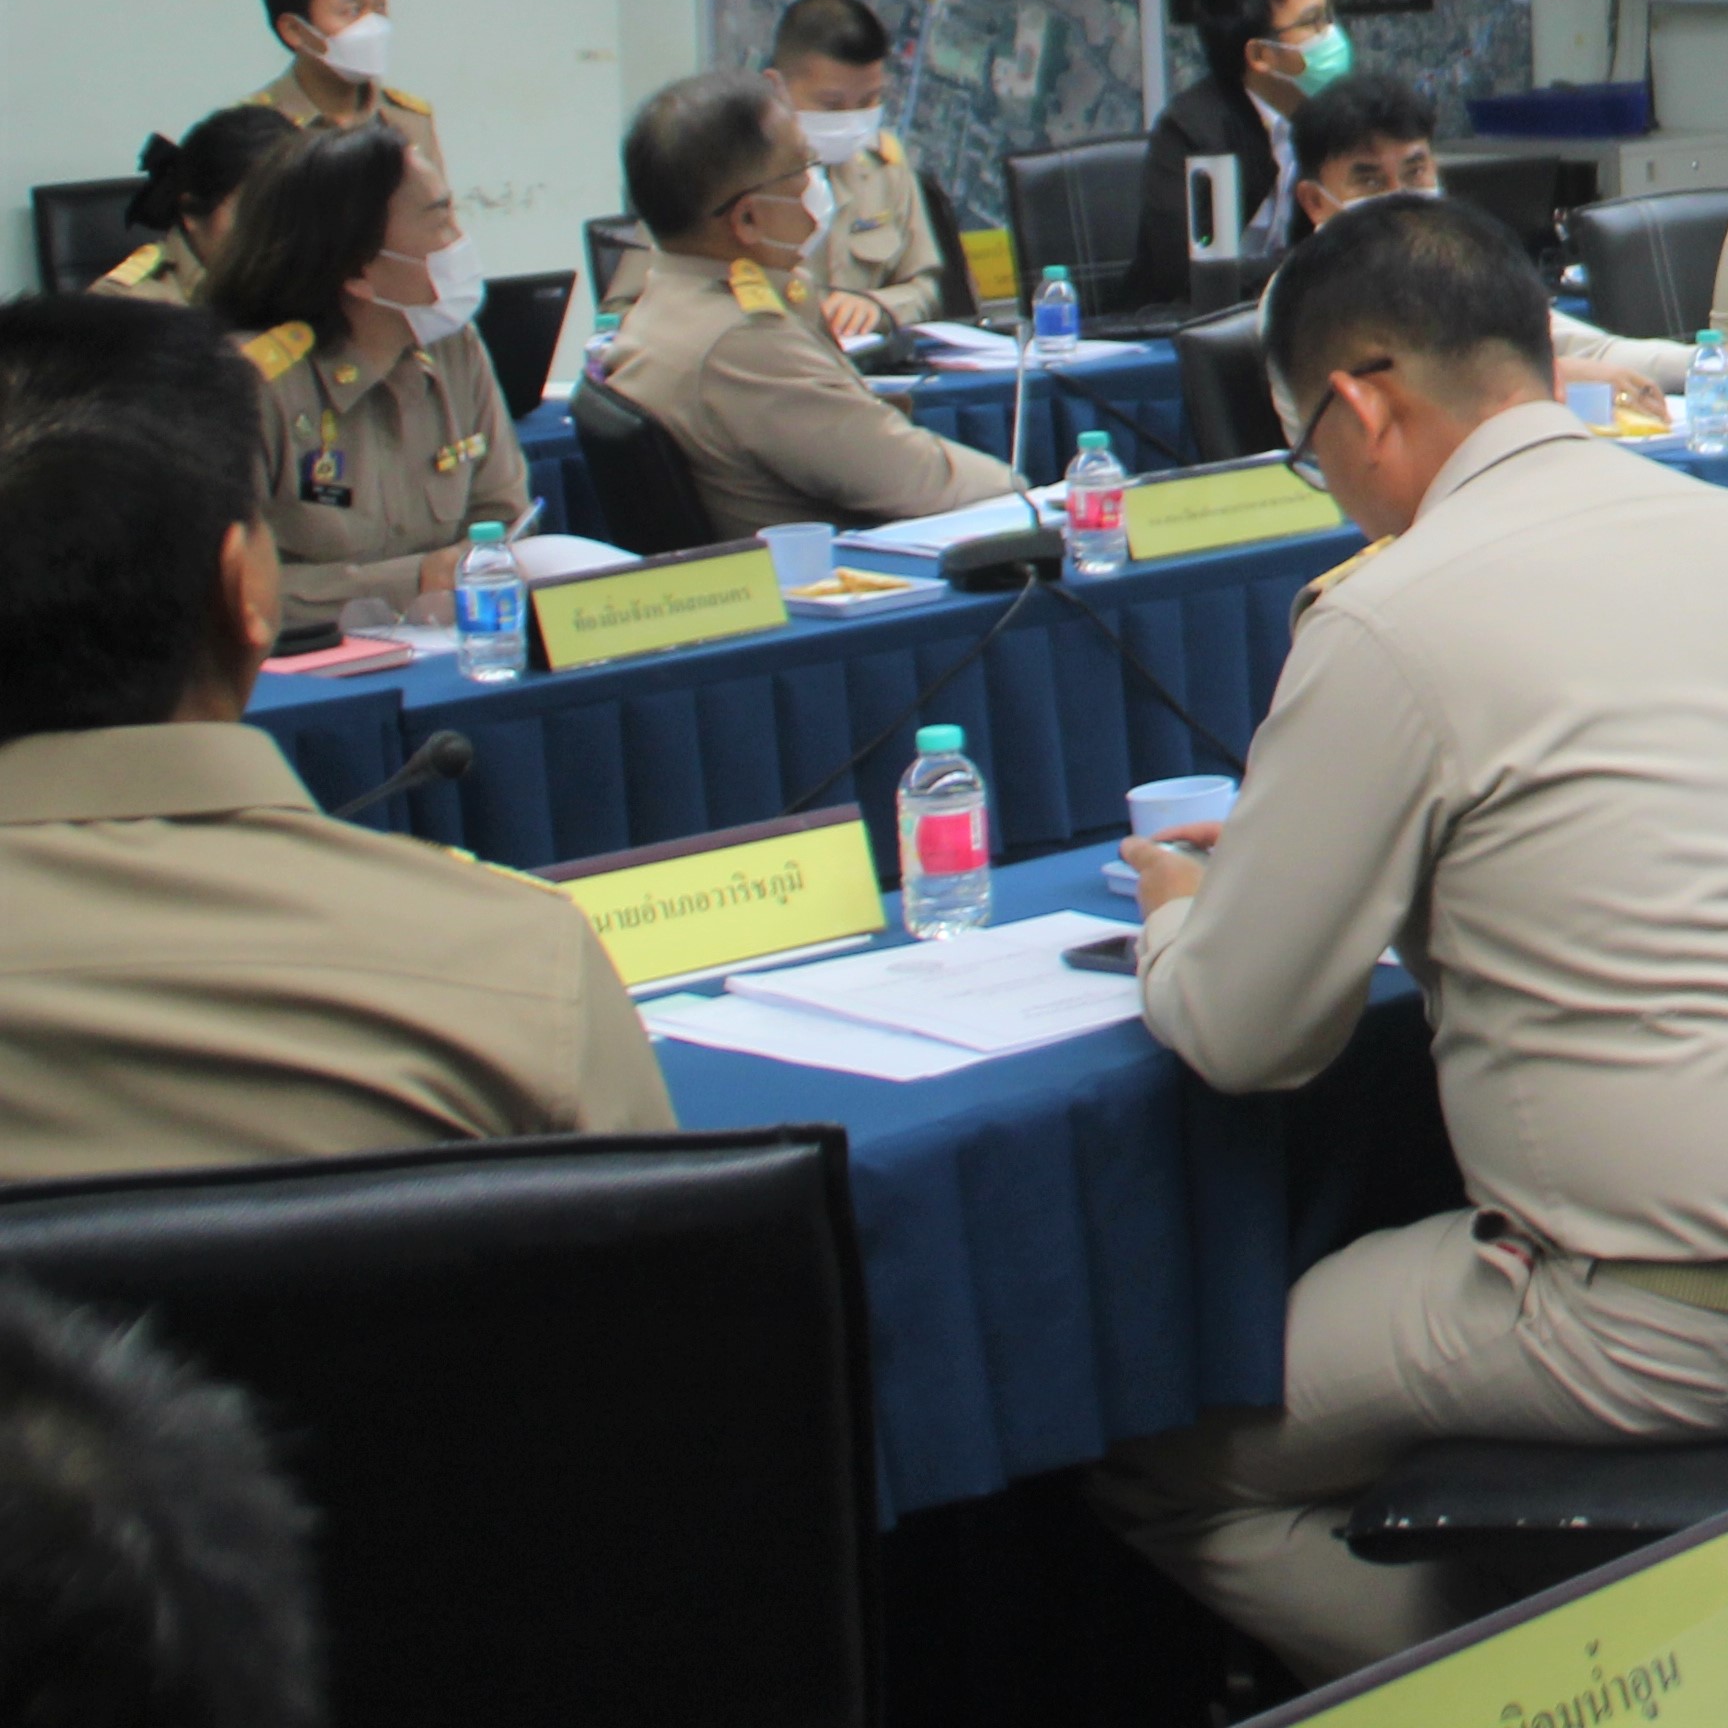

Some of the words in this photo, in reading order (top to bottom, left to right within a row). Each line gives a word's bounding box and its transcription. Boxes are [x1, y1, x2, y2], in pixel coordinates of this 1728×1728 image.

[593, 859, 806, 933] นายอำเภอวาริชภูมิ
